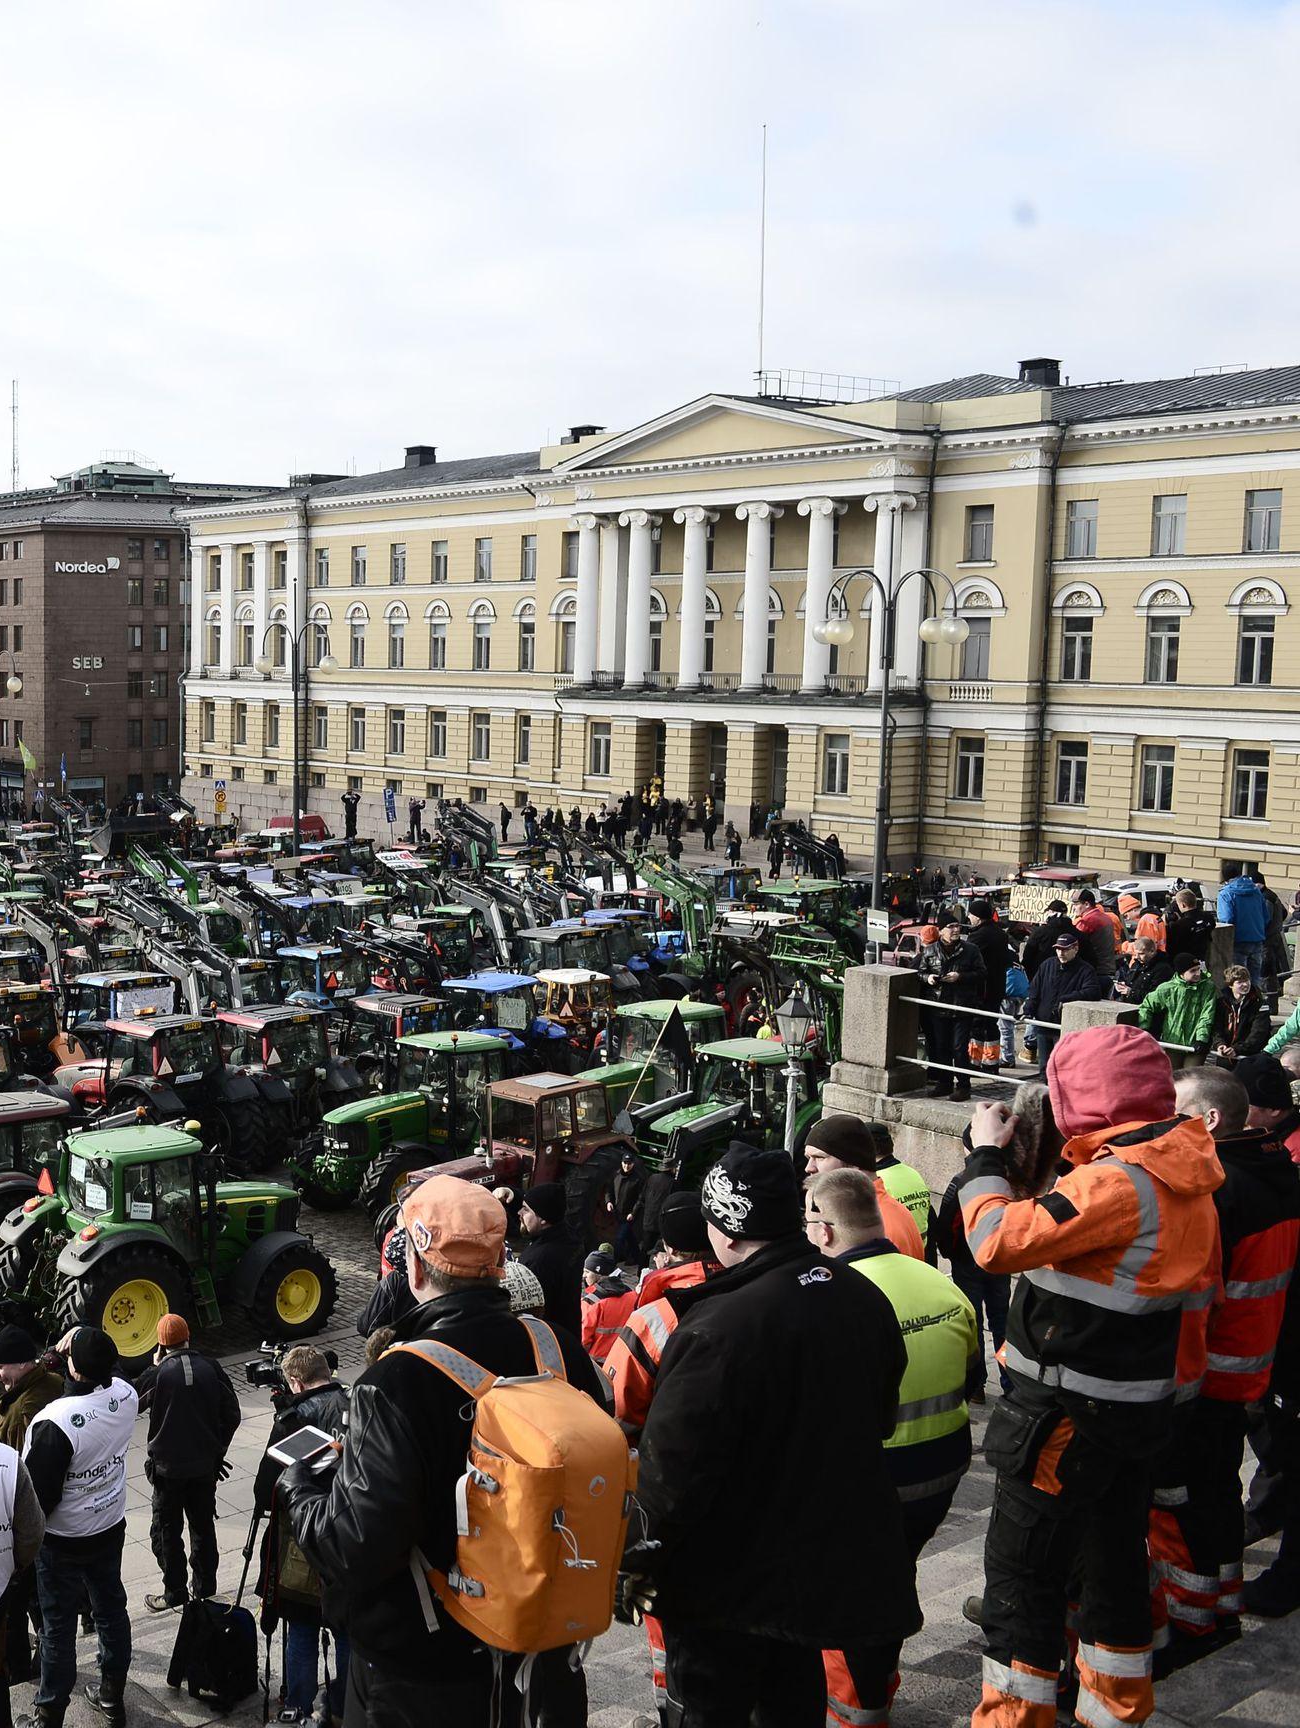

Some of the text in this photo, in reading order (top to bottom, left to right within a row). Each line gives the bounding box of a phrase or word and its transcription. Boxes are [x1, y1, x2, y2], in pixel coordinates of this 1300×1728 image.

[55, 562, 106, 573] Nordea
[72, 656, 103, 669] SEB
[385, 788, 392, 799] P
[1012, 885, 1043, 899] TAHDON
[86, 1409, 98, 1422] SLC
